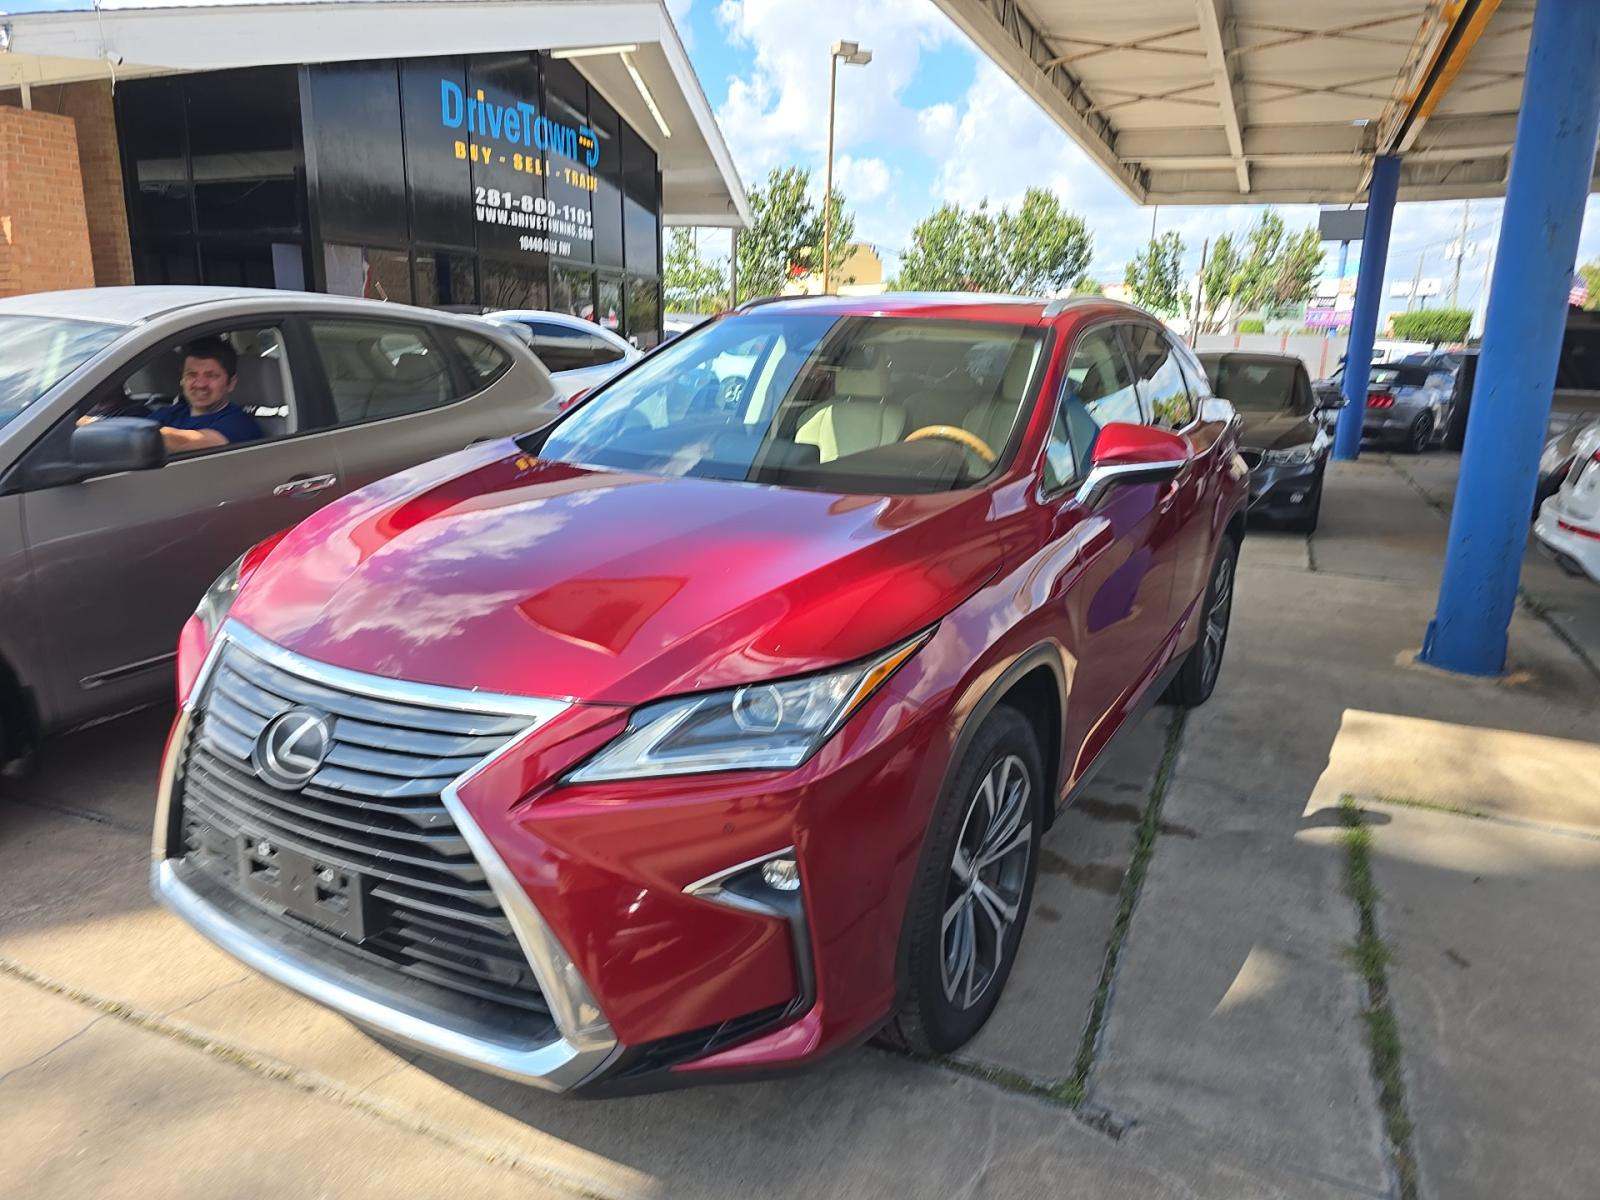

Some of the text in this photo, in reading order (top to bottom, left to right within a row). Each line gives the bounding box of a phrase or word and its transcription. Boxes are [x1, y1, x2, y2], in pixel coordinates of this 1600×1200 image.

[441, 79, 577, 161] DriveTown
[454, 140, 491, 165] BUY
[513, 153, 550, 178] SELL
[475, 186, 592, 226] 281-800-1101
